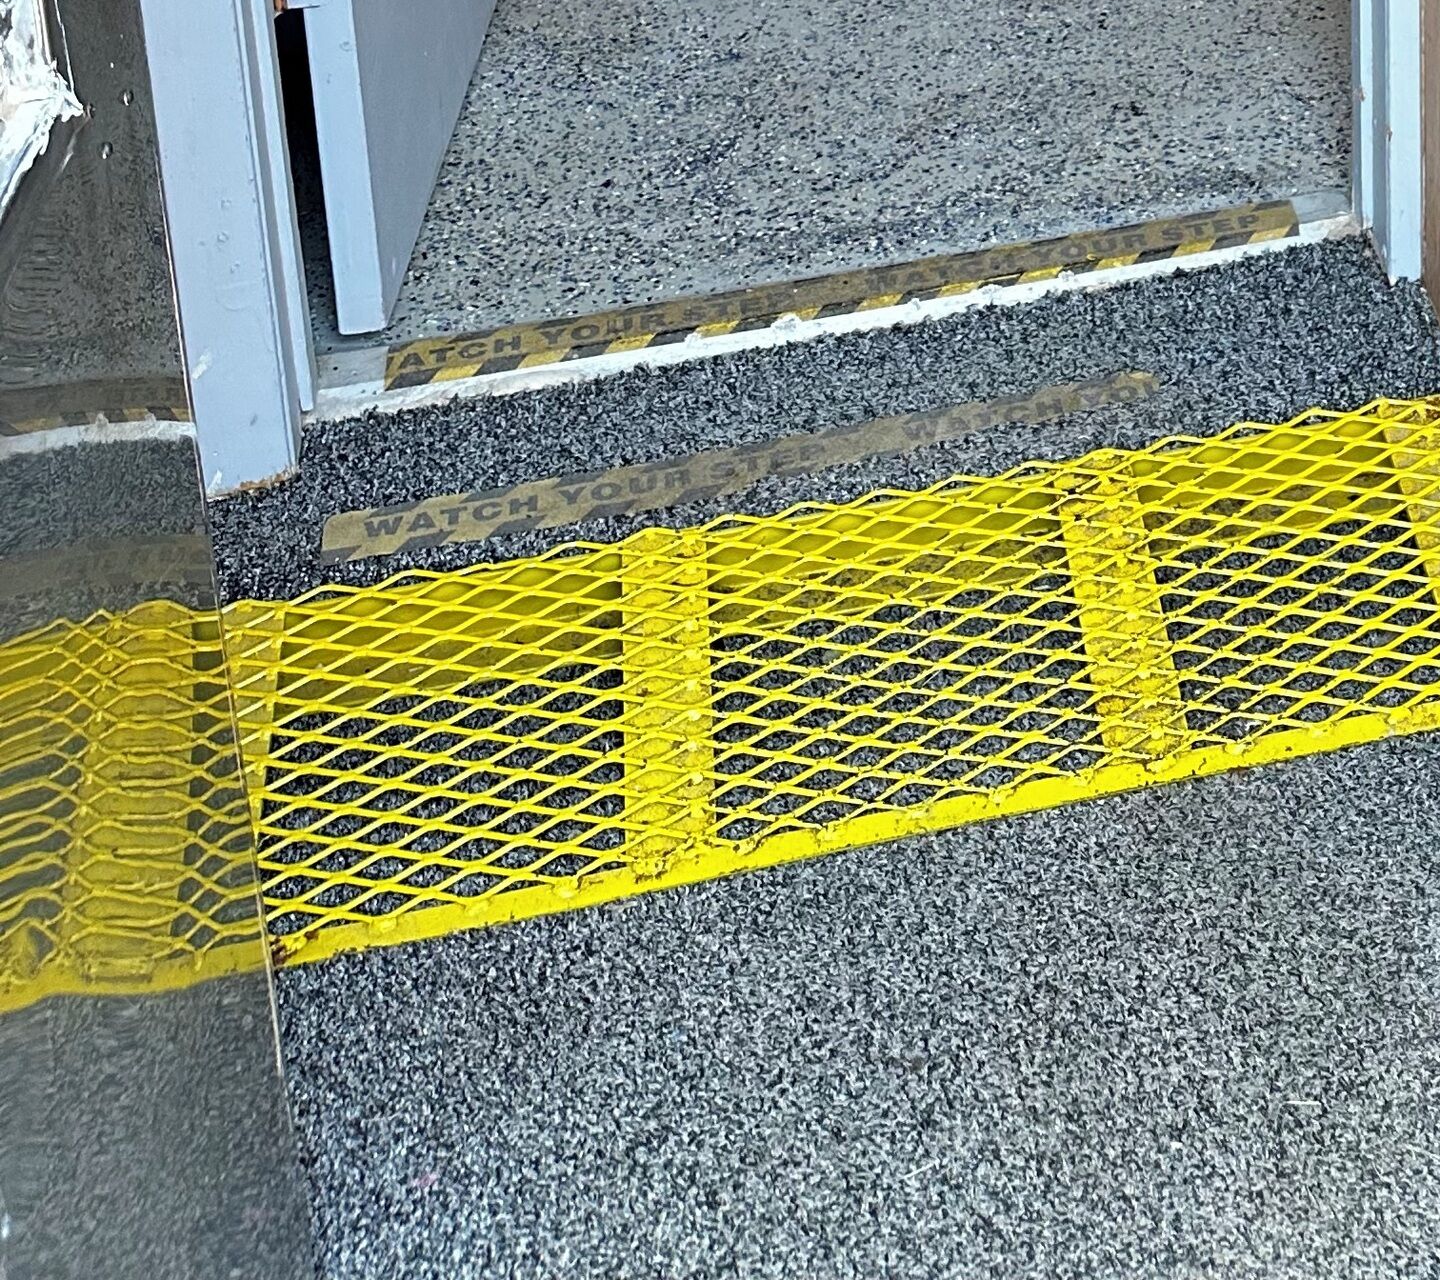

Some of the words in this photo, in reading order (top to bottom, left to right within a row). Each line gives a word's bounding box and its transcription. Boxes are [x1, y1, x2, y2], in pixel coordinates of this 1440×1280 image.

[386, 336, 521, 374] ATCH
[540, 312, 666, 345] YOUR
[1034, 233, 1147, 265] YOUR
[1161, 214, 1260, 241] STEP
[364, 494, 539, 539] WATCH
[559, 465, 692, 507] YOUR
[709, 443, 826, 480] STEP
[902, 397, 1065, 439] WATCH
